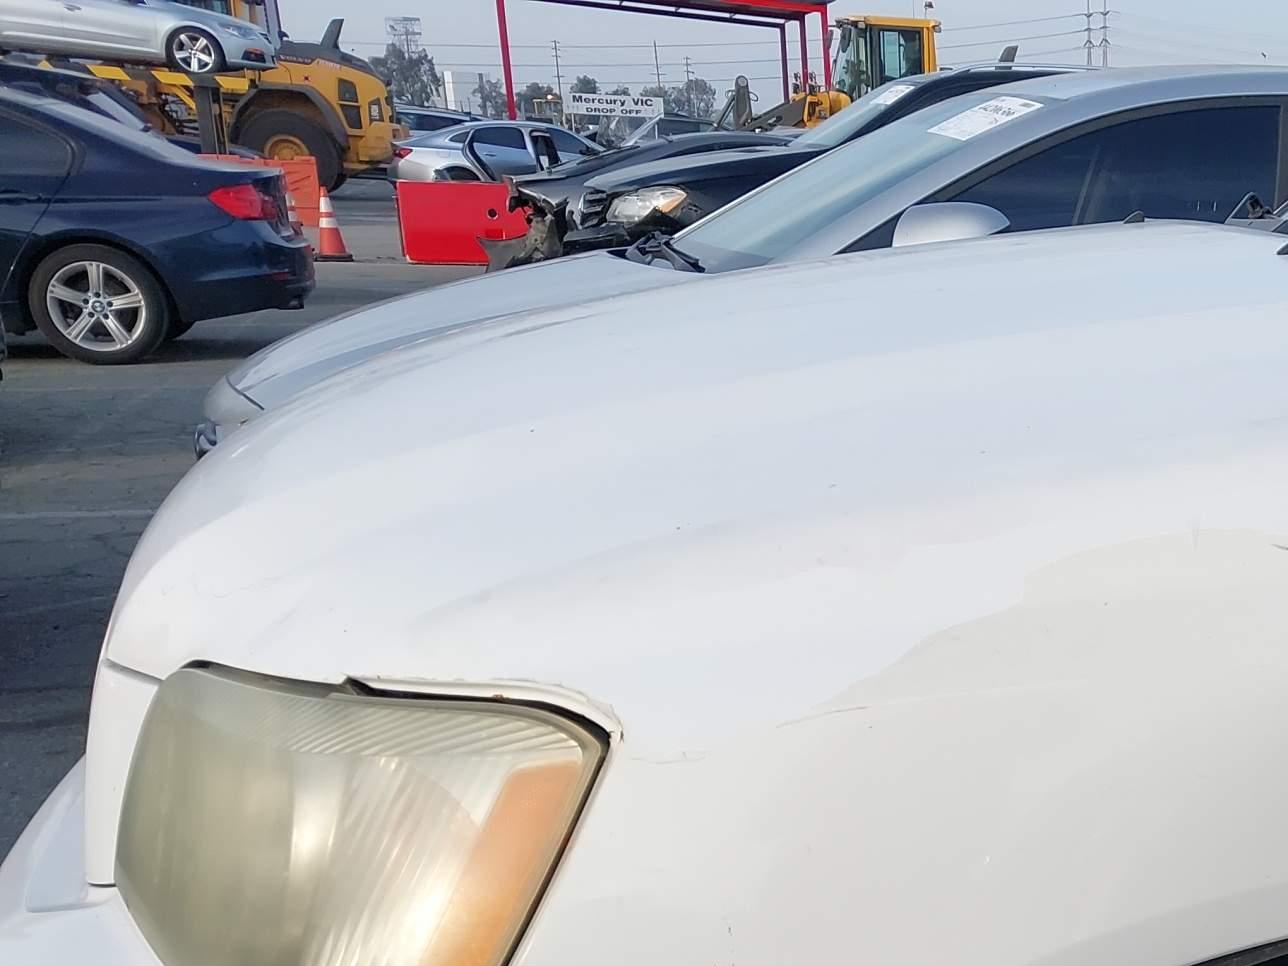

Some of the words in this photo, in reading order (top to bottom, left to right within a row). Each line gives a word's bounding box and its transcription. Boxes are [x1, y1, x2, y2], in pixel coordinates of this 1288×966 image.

[572, 94, 626, 107] Mercury
[632, 97, 653, 106] VIC
[585, 106, 616, 114] DROP
